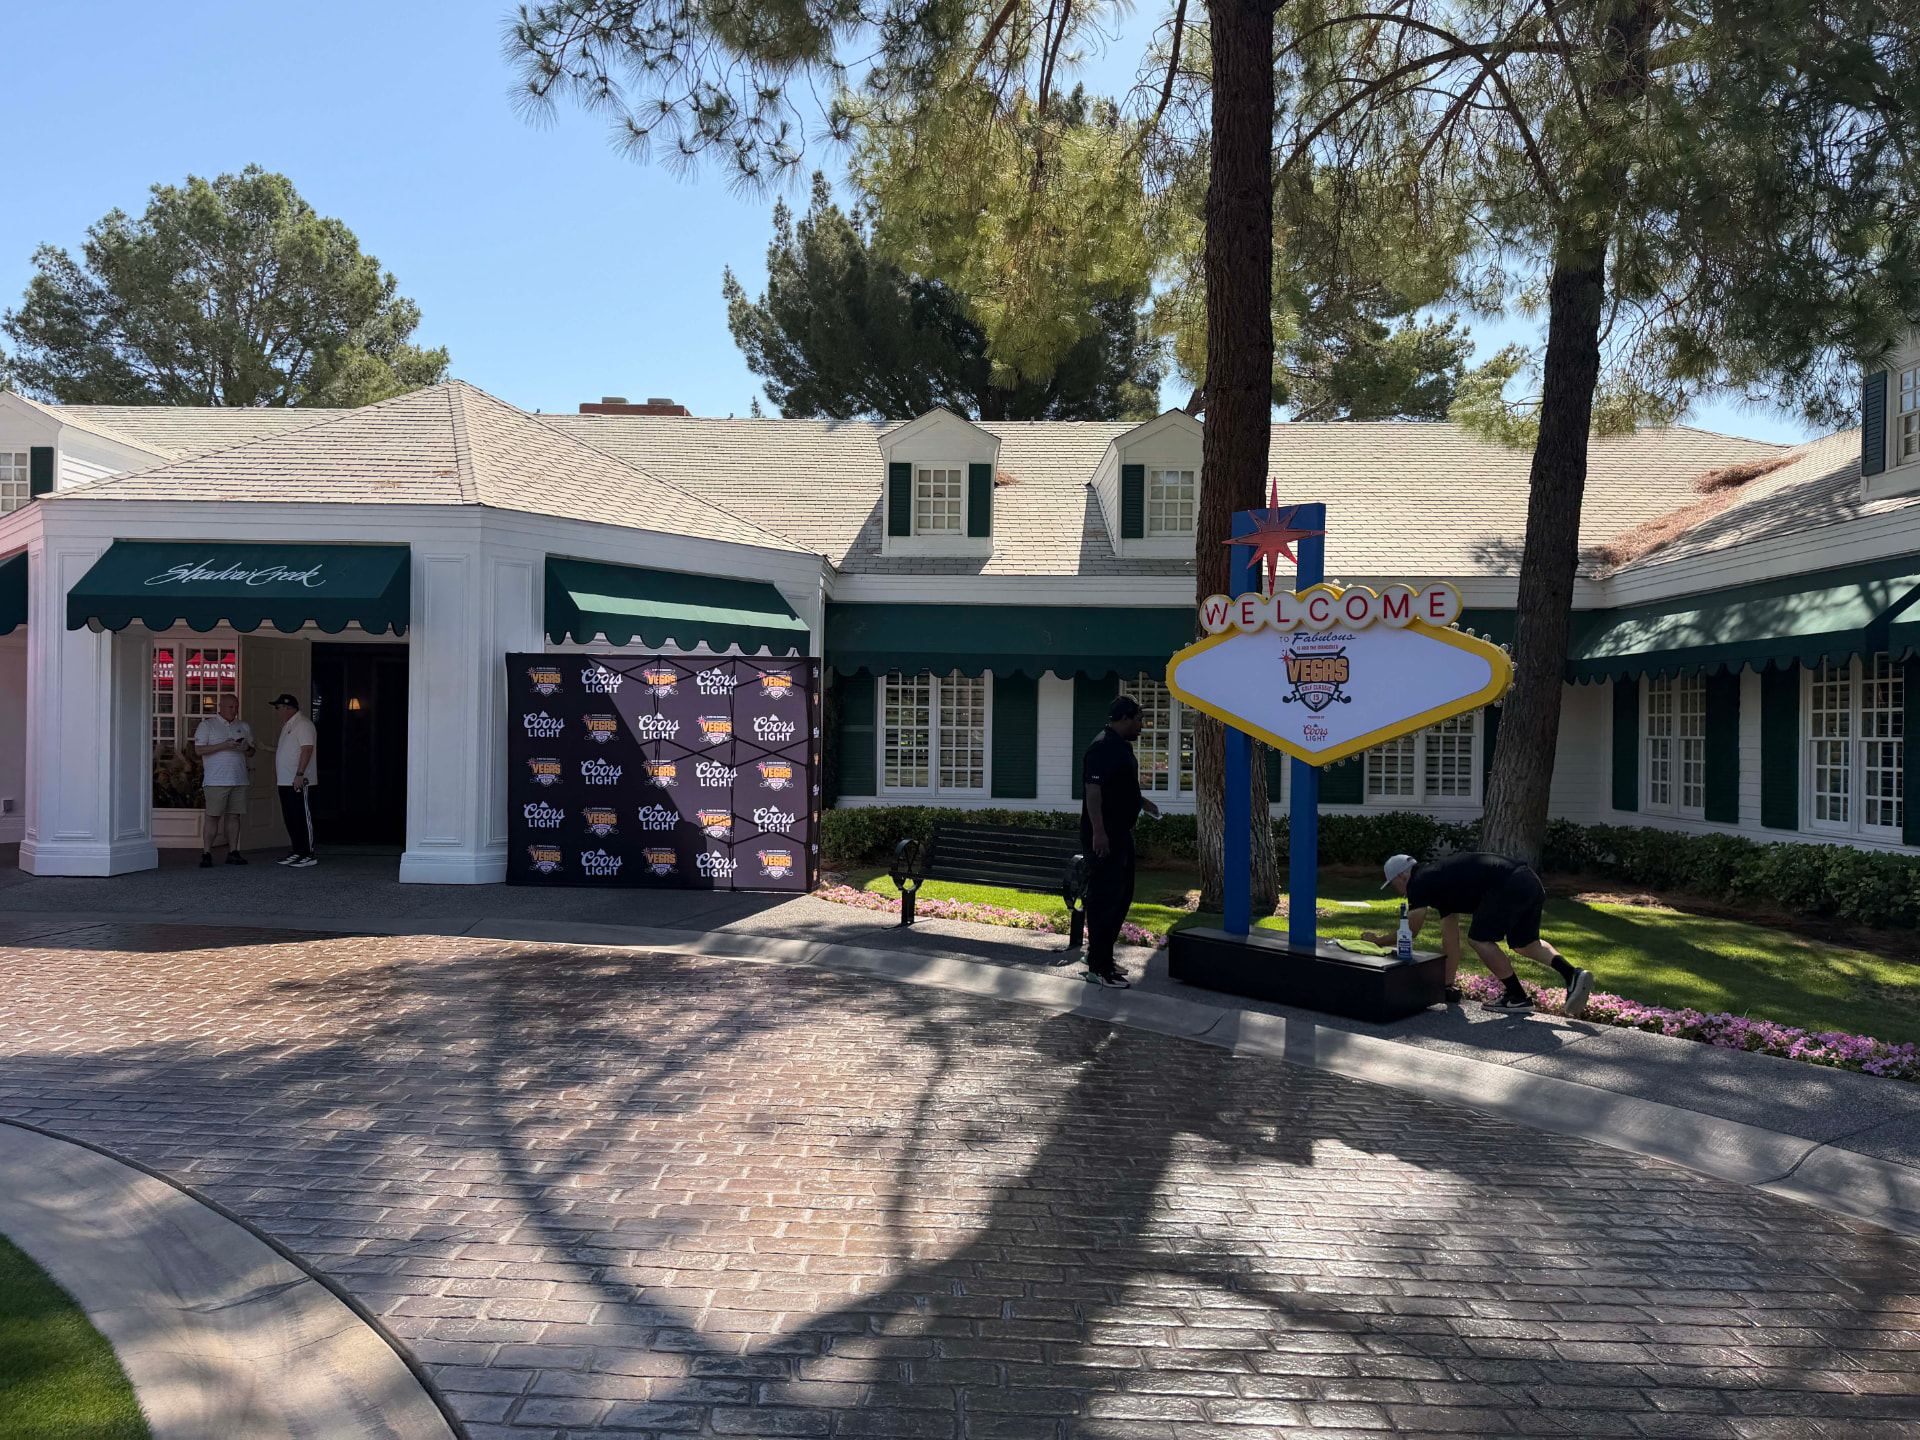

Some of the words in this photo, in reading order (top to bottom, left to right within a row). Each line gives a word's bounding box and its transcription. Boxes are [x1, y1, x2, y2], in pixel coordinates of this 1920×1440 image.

[144, 558, 256, 585] Shadow
[245, 564, 326, 587] Creek
[1205, 591, 1446, 626] WELCOME
[1292, 631, 1357, 645] Fabulous
[1288, 659, 1348, 682] VEGAS
[532, 673, 561, 684] VEGAS
[581, 668, 623, 685] Coors
[648, 674, 677, 685] VEGAS
[696, 670, 738, 686] Coors
[585, 684, 619, 694] LIGHT
[700, 686, 734, 695] LIGHT
[523, 713, 565, 729] Coors
[587, 720, 617, 731] VEGAS
[638, 714, 680, 731] Coors
[753, 716, 796, 733] Coors
[703, 722, 732, 733] VEGAS
[1303, 724, 1329, 736] Coors
[528, 729, 560, 738] LIGHT
[643, 731, 676, 740] LIGHT
[758, 732, 791, 741] LIGHT
[532, 764, 561, 774] VEGAS
[581, 760, 623, 777] Coors
[647, 766, 676, 777] VEGAS
[695, 762, 738, 778] Coors
[763, 767, 792, 778] VEGAS
[585, 776, 619, 785] LIGHT
[700, 778, 733, 787] LIGHT
[523, 803, 566, 819] Coors
[638, 805, 680, 822] Coors
[753, 807, 796, 824] Coors
[528, 819, 561, 828] LIGHT
[587, 813, 617, 824] VEGAS
[643, 822, 676, 831] LIGHT
[758, 824, 791, 833] LIGHT
[532, 851, 561, 862] VEGAS
[581, 850, 623, 867] Coors
[647, 853, 676, 864] VEGAS
[696, 852, 738, 869] Coors
[763, 856, 792, 867] VEGAS
[585, 867, 619, 876] LIGHT
[700, 869, 734, 878] LIGHT
